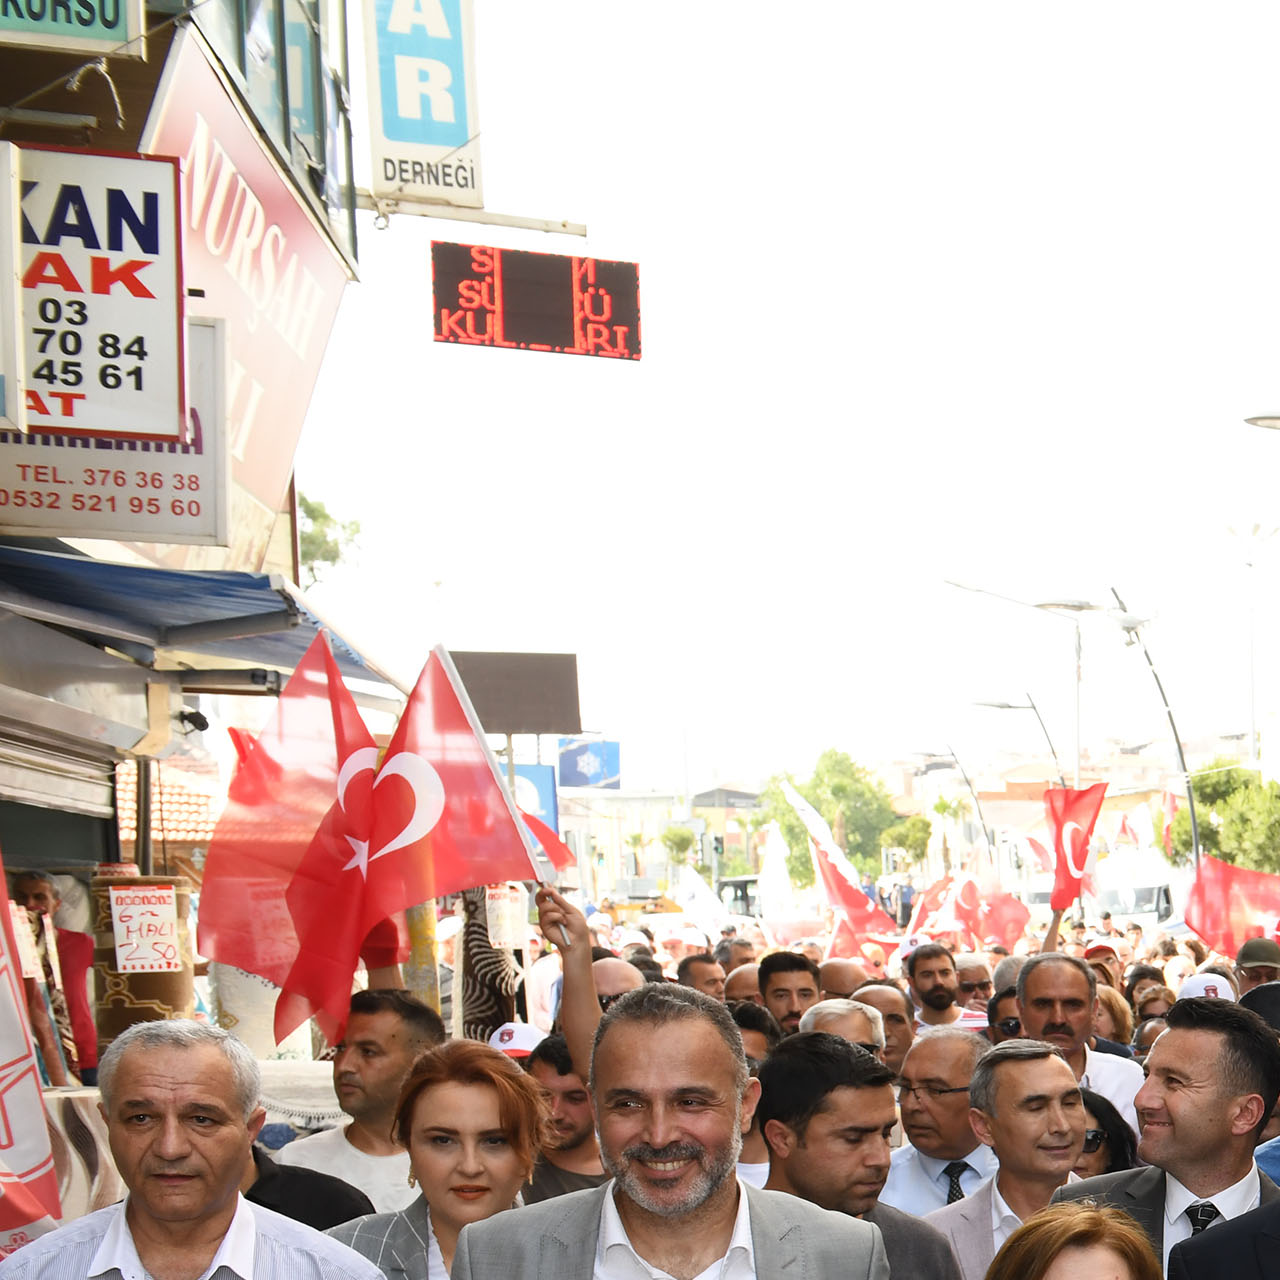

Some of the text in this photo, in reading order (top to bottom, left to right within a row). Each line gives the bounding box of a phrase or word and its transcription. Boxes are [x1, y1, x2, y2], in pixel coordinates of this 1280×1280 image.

[383, 158, 476, 189] DERNEĞİ
[38, 298, 89, 326] 03
[32, 327, 148, 361] 70 84
[32, 359, 144, 391] 45 61
[16, 463, 201, 491] TEL. 376 36 38
[72, 494, 117, 513] 521
[129, 496, 161, 515] 95
[170, 498, 201, 517] 60
